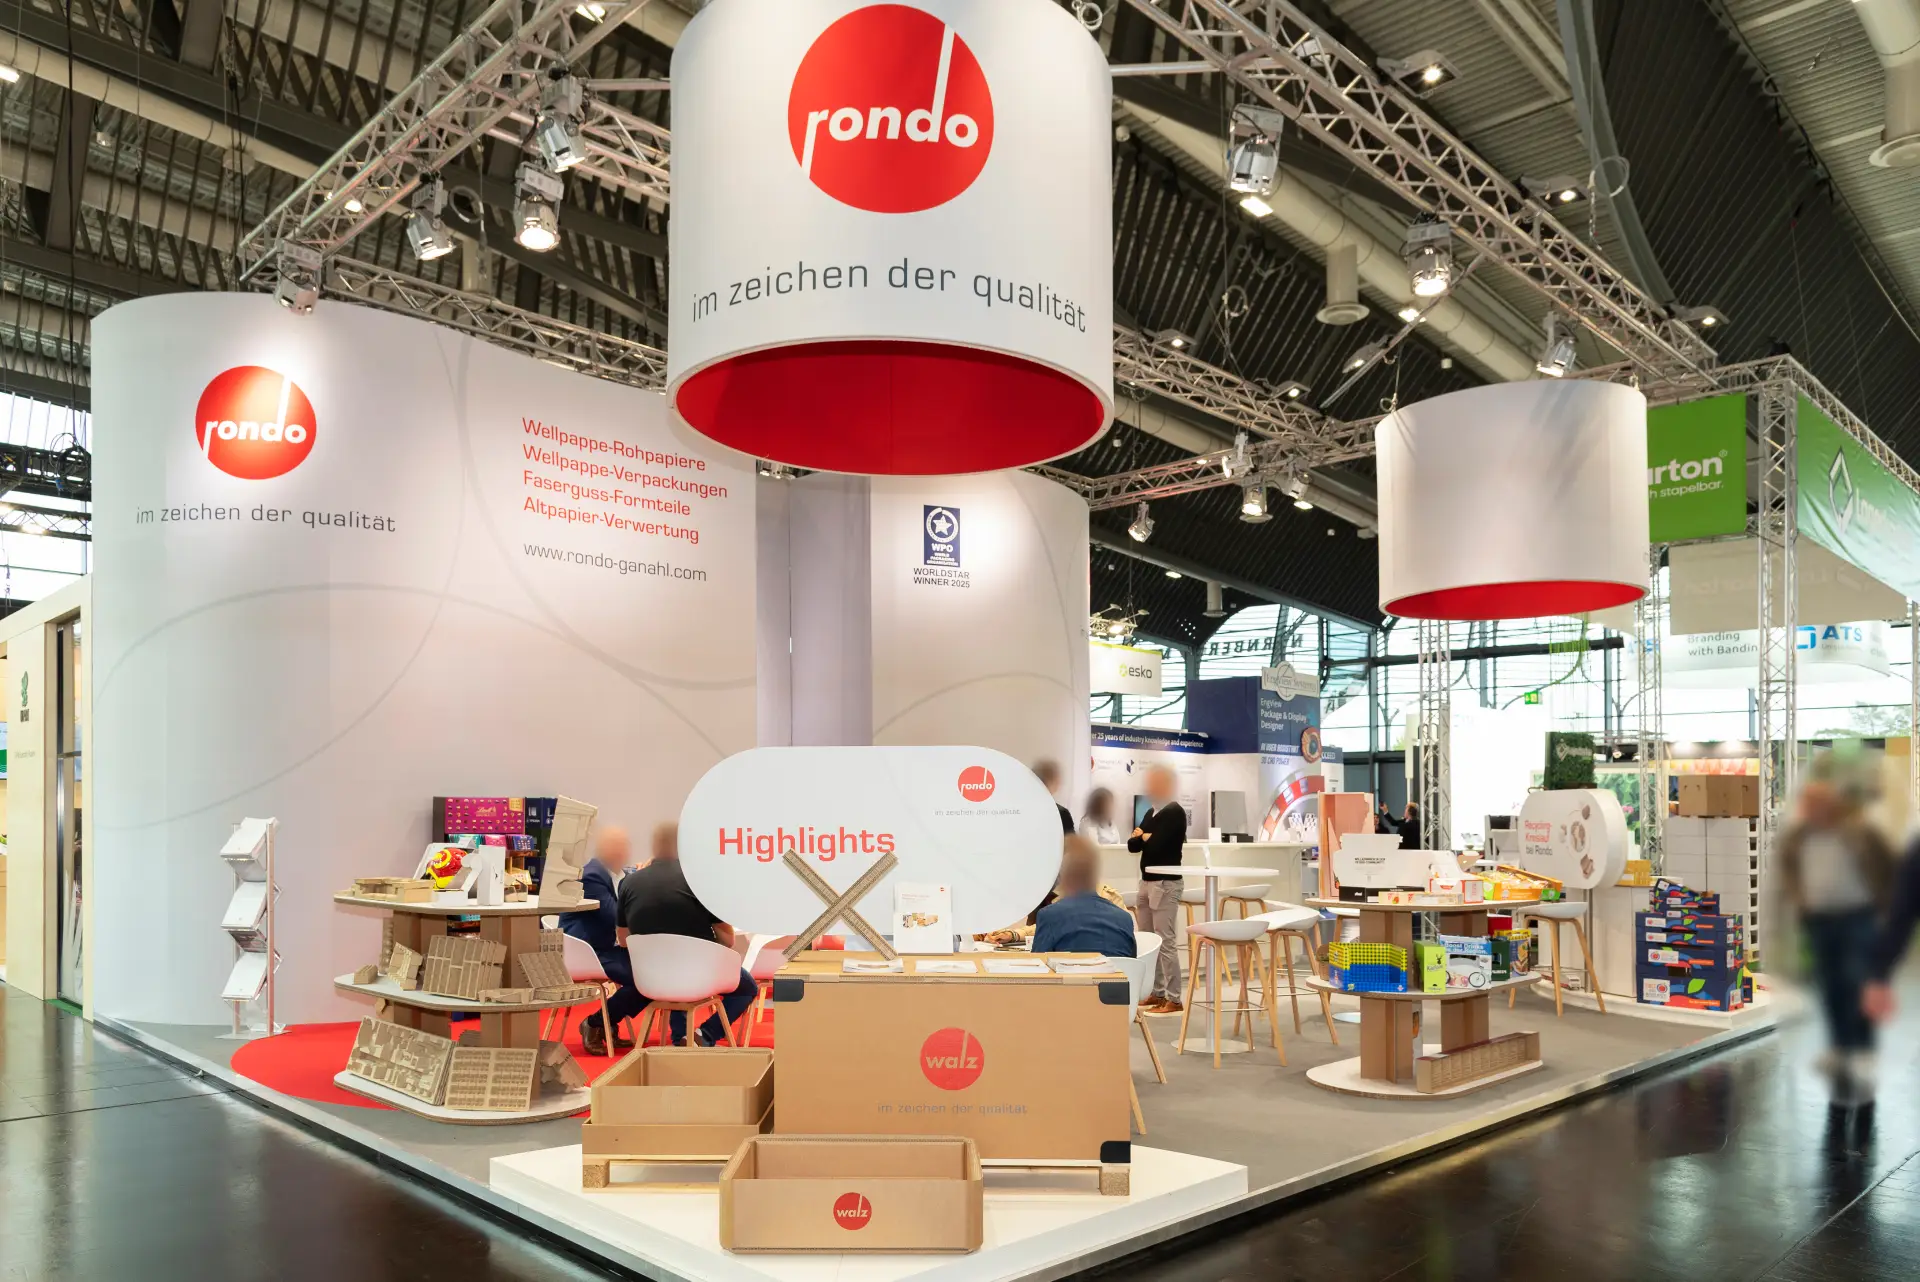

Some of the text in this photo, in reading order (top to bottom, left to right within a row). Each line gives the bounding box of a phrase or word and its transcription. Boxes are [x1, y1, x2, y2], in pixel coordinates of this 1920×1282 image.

[802, 24, 979, 178] rondo
[691, 258, 1087, 333] im zeichen der qualität
[202, 375, 307, 458] rondo
[522, 417, 706, 471] Wellpappe-Rohpapiere
[523, 443, 728, 499] Wellpappe-Verpackungen
[523, 470, 691, 516] Faserguss-Formteile
[1660, 481, 1724, 497] stapelbar.
[136, 503, 396, 533] im zeichen der qualität
[523, 496, 699, 545] Altpapier-Verwertung
[931, 543, 953, 552] WPO
[524, 543, 707, 581] www.rondo-ganahl.com
[913, 568, 970, 580] WORLDSTAR
[913, 577, 970, 589] WINNER 2025
[1822, 626, 1863, 642] ATS
[1688, 644, 1759, 656] with Bandin
[1128, 664, 1153, 679] esko
[1261, 710, 1282, 721] Package
[1261, 721, 1284, 731] Designer
[1104, 734, 1118, 742] years
[1119, 733, 1124, 741] of
[1125, 734, 1145, 744] industry
[961, 768, 992, 796] rondo
[719, 826, 895, 862] Highlights
[926, 1030, 978, 1069] walz
[877, 1103, 892, 1114] im
[898, 1103, 946, 1114] zeichen
[952, 1103, 973, 1114] der
[836, 1193, 868, 1218] walz
